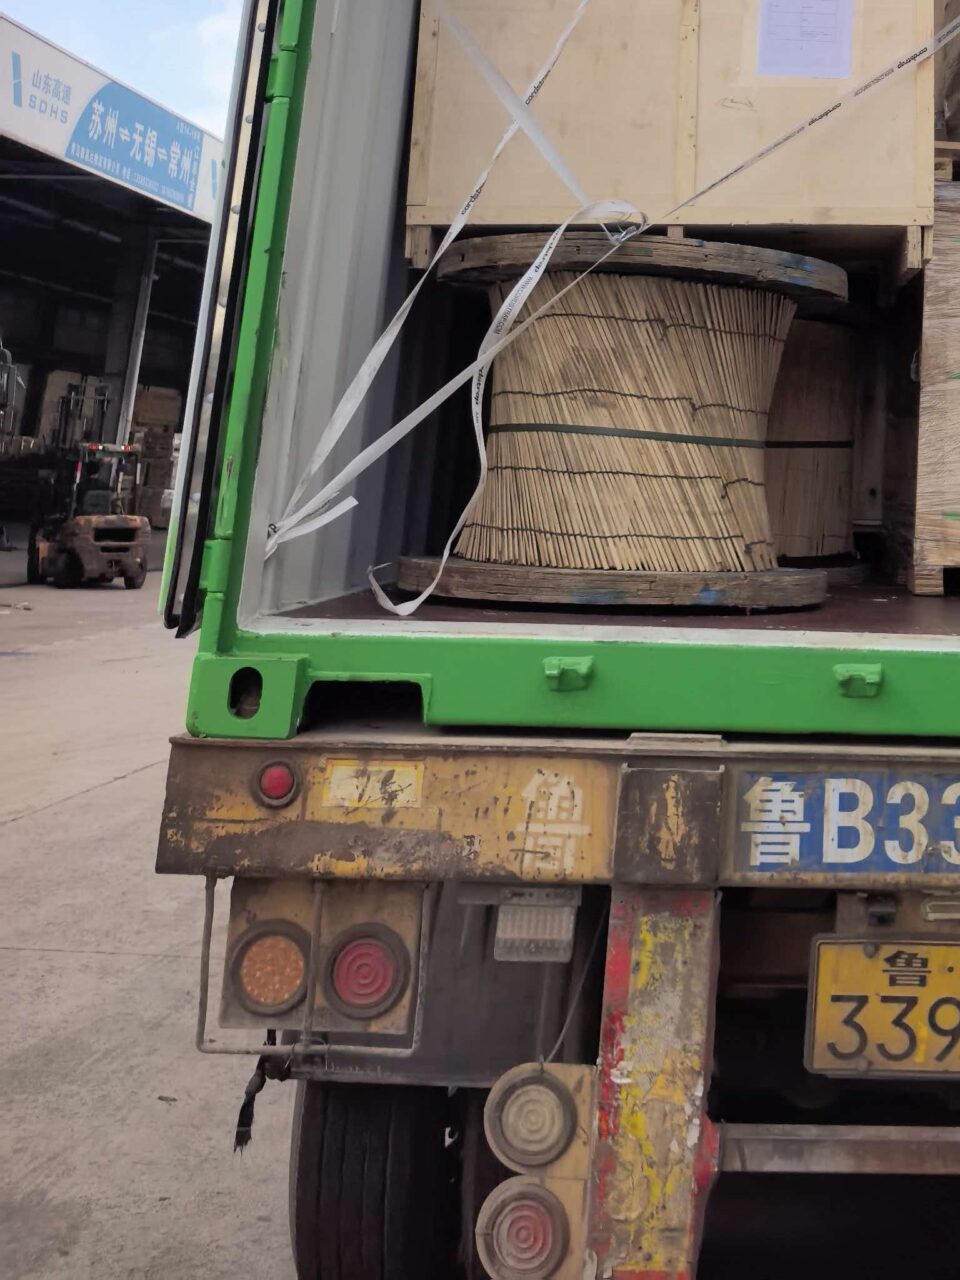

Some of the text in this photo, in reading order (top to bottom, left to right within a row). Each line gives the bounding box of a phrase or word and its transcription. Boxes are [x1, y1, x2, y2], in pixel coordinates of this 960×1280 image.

[895, 45, 929, 70] cordstrap
[31, 68, 73, 105] 山东高速
[88, 99, 119, 149] 苏州
[129, 121, 158, 168] 无锡
[168, 140, 193, 185] 常州
